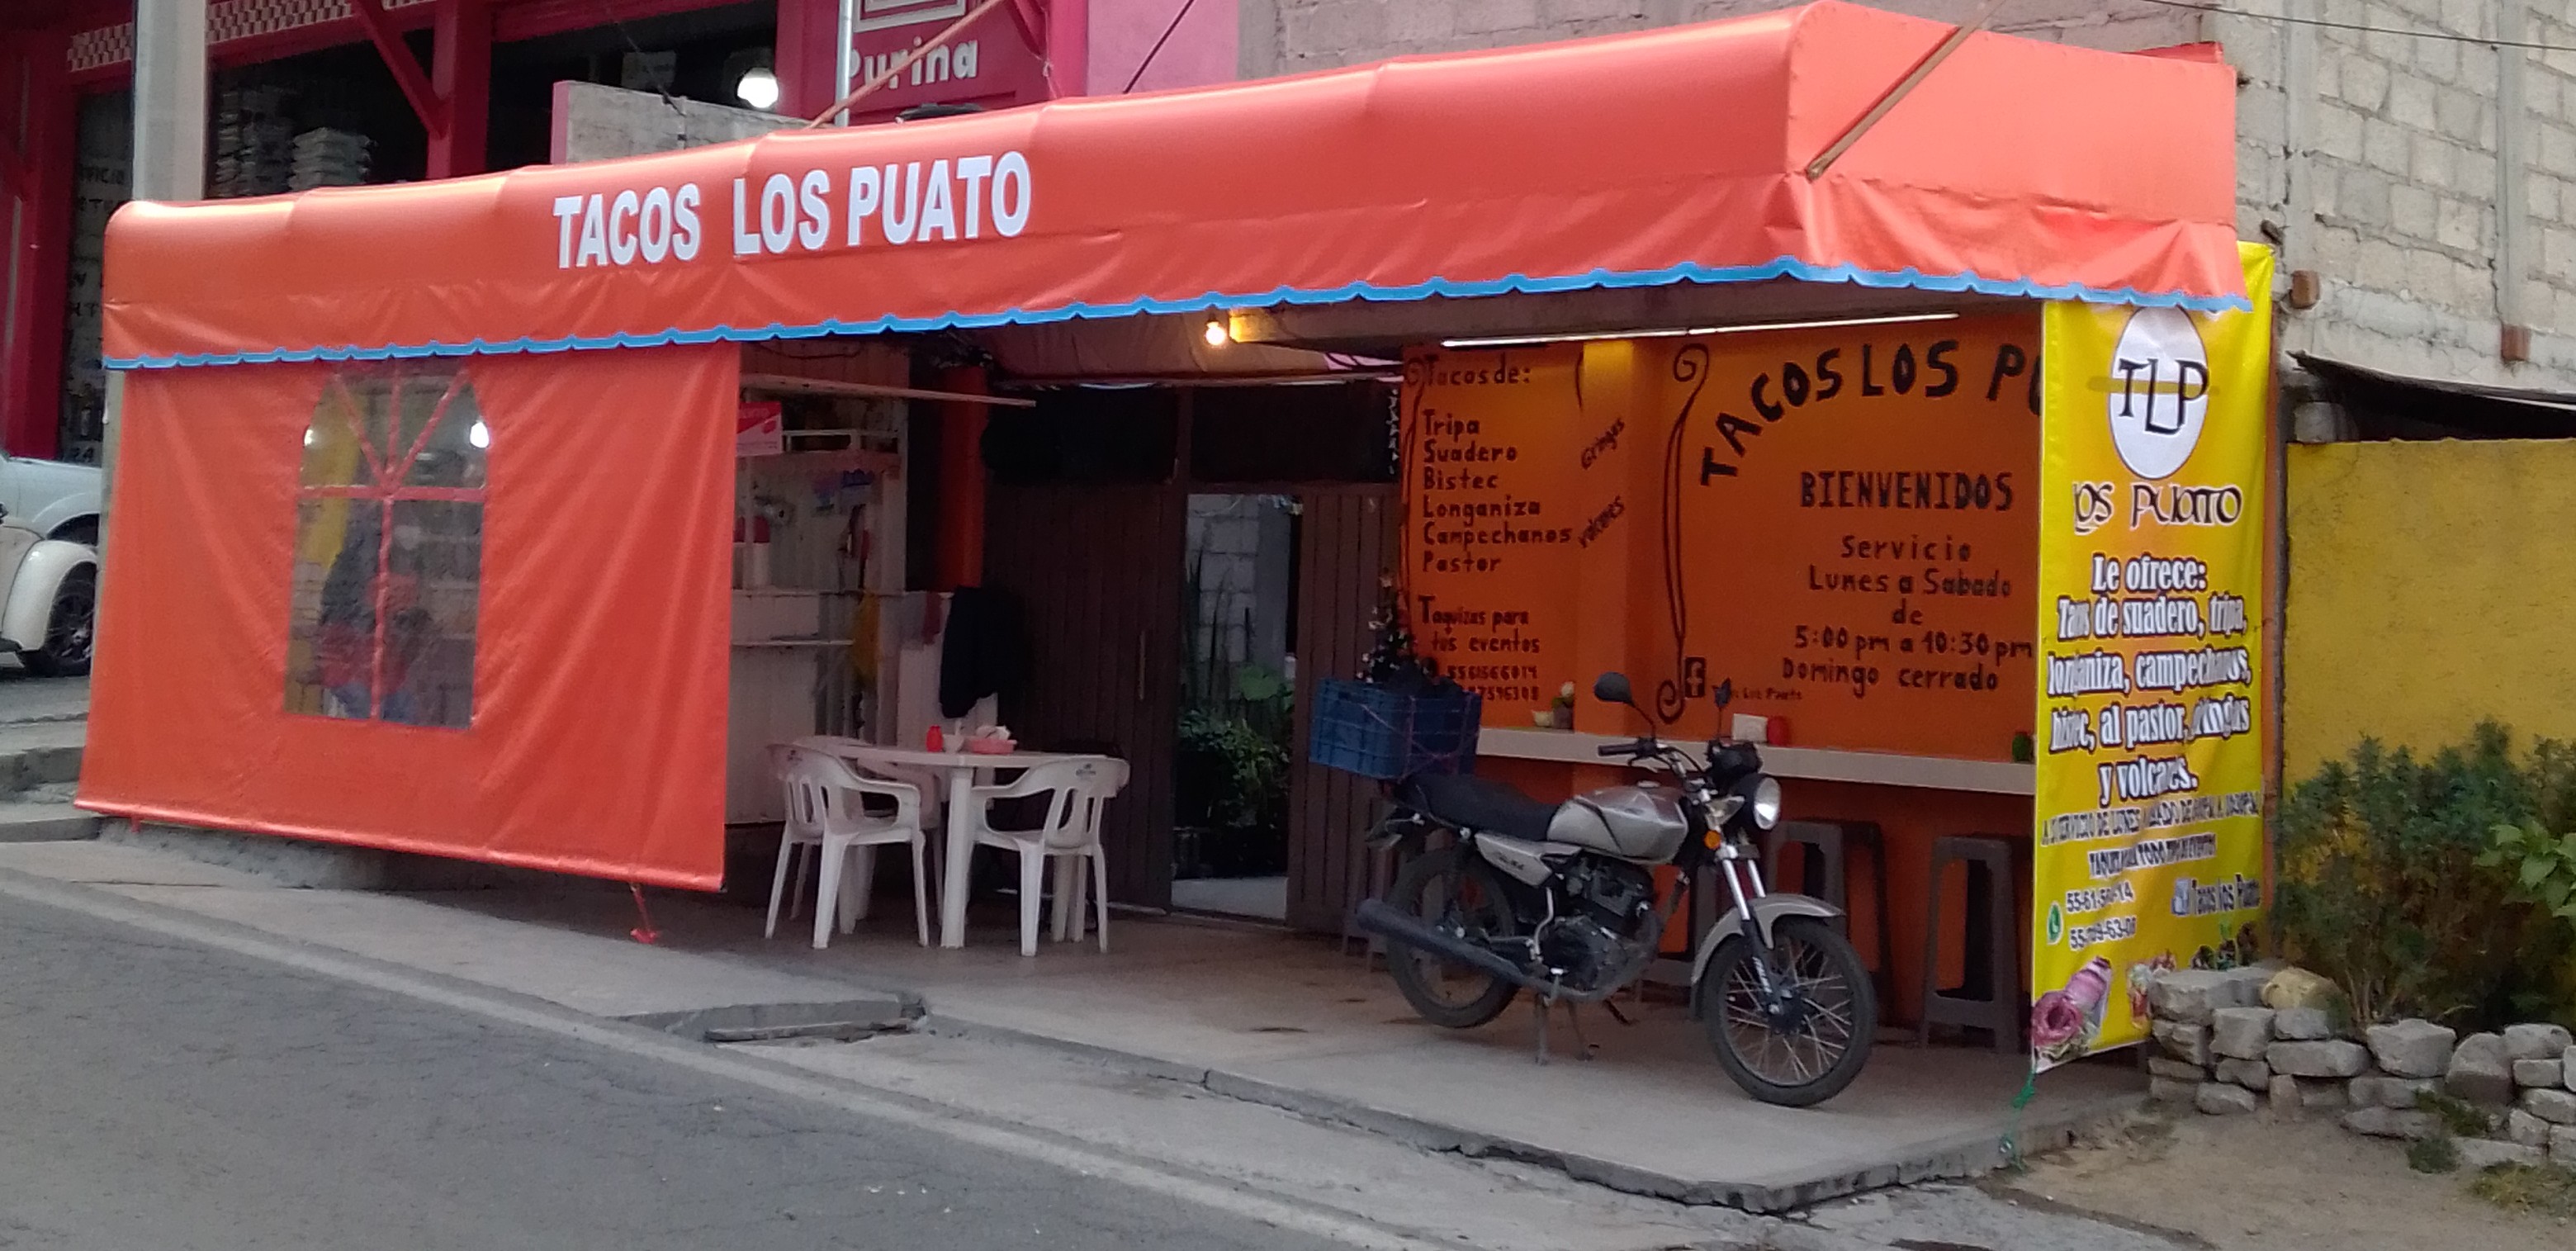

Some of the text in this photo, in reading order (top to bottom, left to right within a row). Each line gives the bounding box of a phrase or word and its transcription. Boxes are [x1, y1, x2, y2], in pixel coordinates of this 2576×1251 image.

[552, 151, 1032, 269] TACOS LOS PUATO
[1424, 352, 1532, 386] Tacos de:
[1422, 409, 1480, 442] Tripa
[1700, 347, 1844, 487] TACOS
[1861, 339, 1958, 398] LOS
[1423, 438, 1518, 464] Suadero
[1423, 465, 1499, 490] Bistec
[1800, 471, 2013, 511] BIENVENIDOS
[1423, 494, 1540, 527] Longaniza
[1423, 520, 1573, 552] Campechanos
[1840, 534, 1972, 561] Servicio
[1422, 549, 1501, 573] Pastor
[2091, 552, 2208, 594] Le ofrece:
[1808, 564, 2011, 597] Lunes a Sabado
[1492, 609, 1529, 633] para
[1892, 598, 1923, 626] de
[2095, 594, 2119, 637] de
[2121, 595, 2205, 639] suadero,
[1431, 628, 1541, 654] tus eventos
[1794, 624, 2033, 666] 5:00 pm a 10:30 pm
[1782, 657, 1998, 699] Domingo cerrado
[2100, 702, 2123, 747] al
[2098, 763, 2112, 807] y
